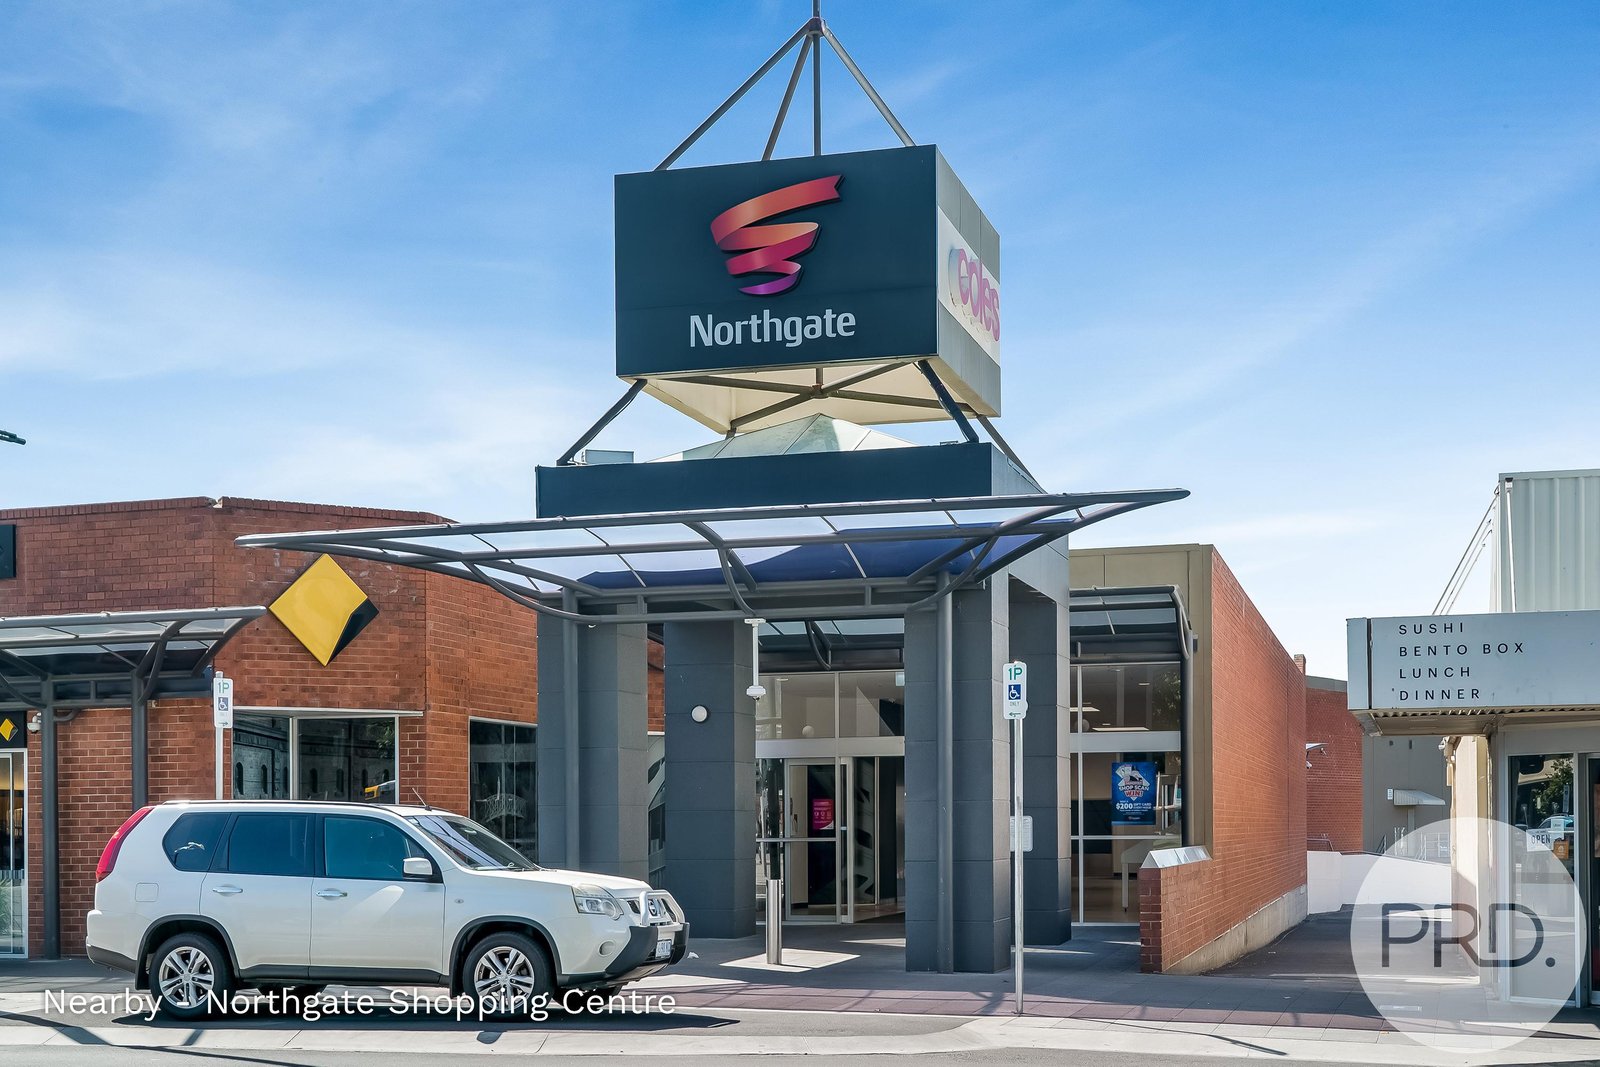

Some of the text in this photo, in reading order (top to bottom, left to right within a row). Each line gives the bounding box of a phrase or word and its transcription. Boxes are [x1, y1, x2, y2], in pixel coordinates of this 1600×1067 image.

[956, 248, 1000, 342] coles
[690, 309, 856, 348] Northgate
[1398, 622, 1464, 635] SUSHI
[1399, 642, 1524, 657] BENTO BOX
[1008, 667, 1023, 681] 1P
[1399, 666, 1471, 679] LUNCH
[218, 682, 230, 694] 1P
[1399, 688, 1480, 701] DINNER
[1532, 834, 1550, 844] OPEN
